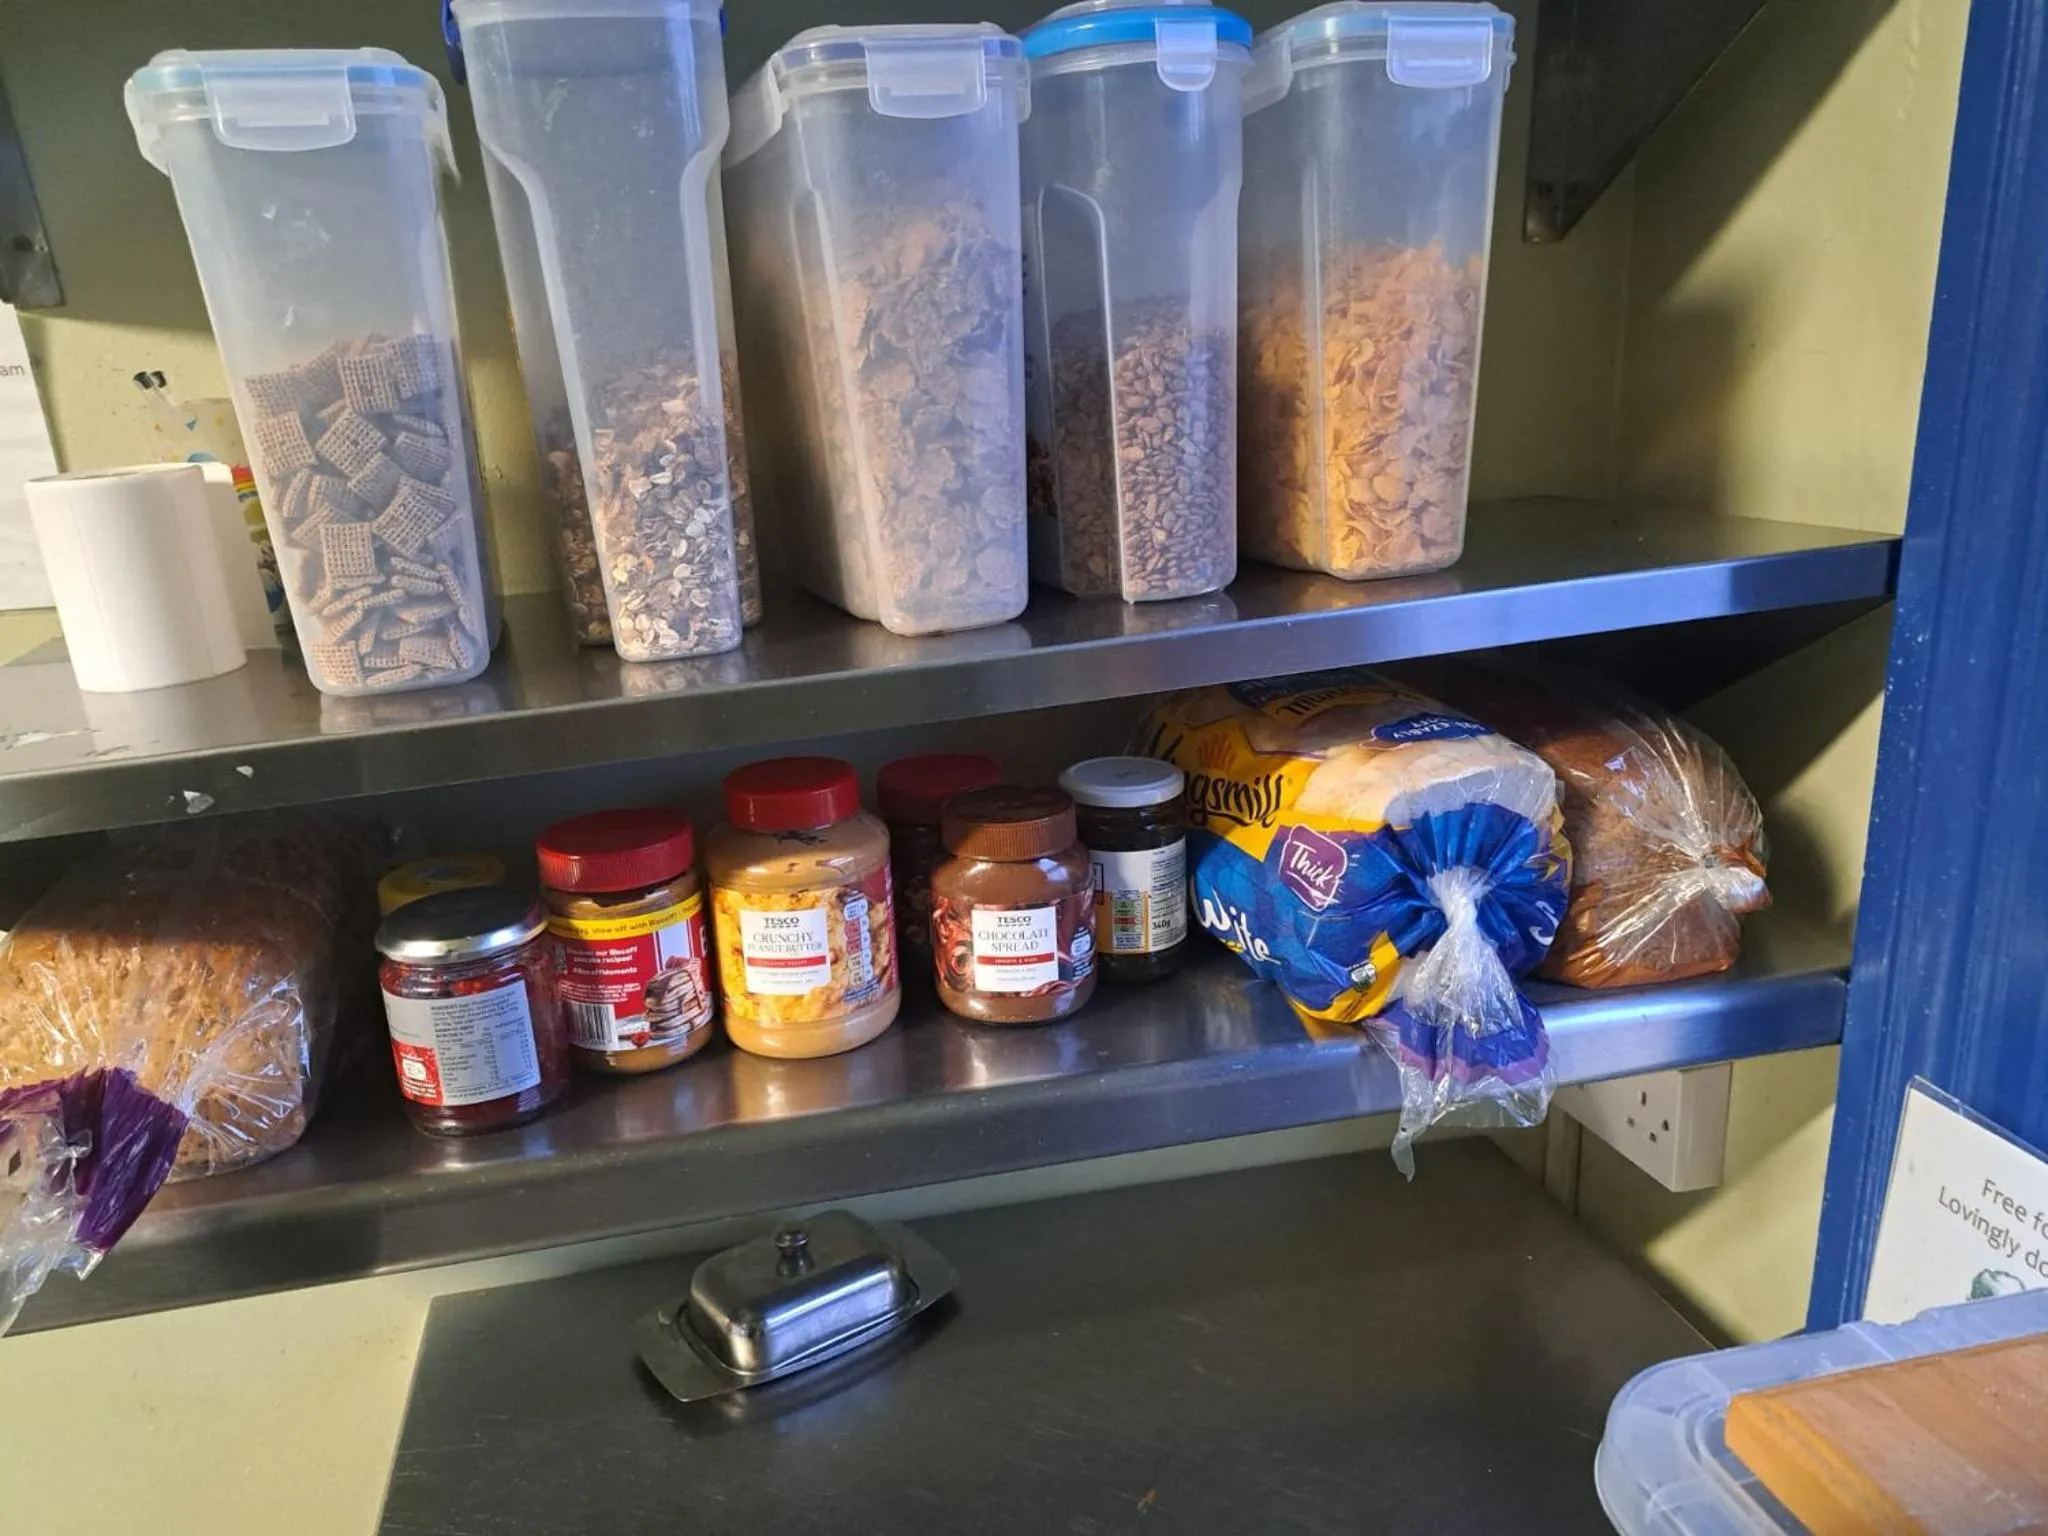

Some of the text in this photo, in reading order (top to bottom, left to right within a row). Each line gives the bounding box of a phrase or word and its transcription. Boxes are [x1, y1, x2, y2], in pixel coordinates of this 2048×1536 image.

[1288, 840, 1334, 888] Thick
[763, 916, 801, 928] TESCO
[997, 915, 1032, 927] TESCO
[752, 931, 814, 944] CRUNCHY
[991, 940, 1039, 952] SPREAD
[1982, 1178, 2028, 1224] Free
[1938, 1185, 2021, 1259] Lovingly
